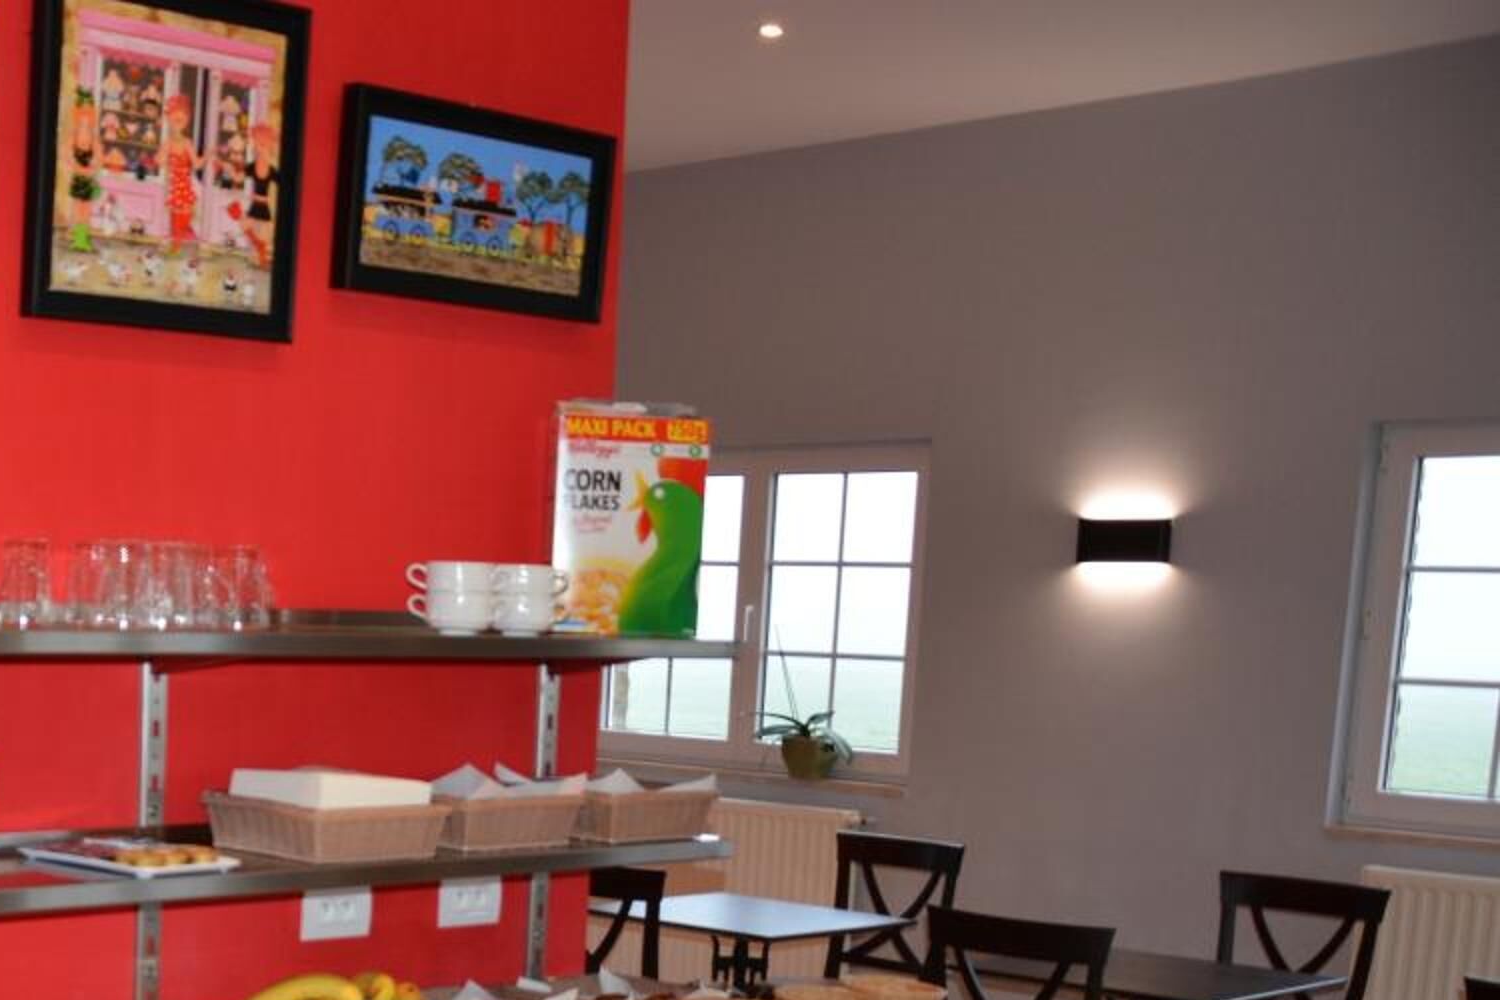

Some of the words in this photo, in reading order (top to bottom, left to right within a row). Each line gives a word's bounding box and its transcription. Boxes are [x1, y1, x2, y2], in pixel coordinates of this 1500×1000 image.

[566, 417, 609, 436] MAXI
[612, 419, 656, 438] PACK
[564, 468, 621, 492] CORN
